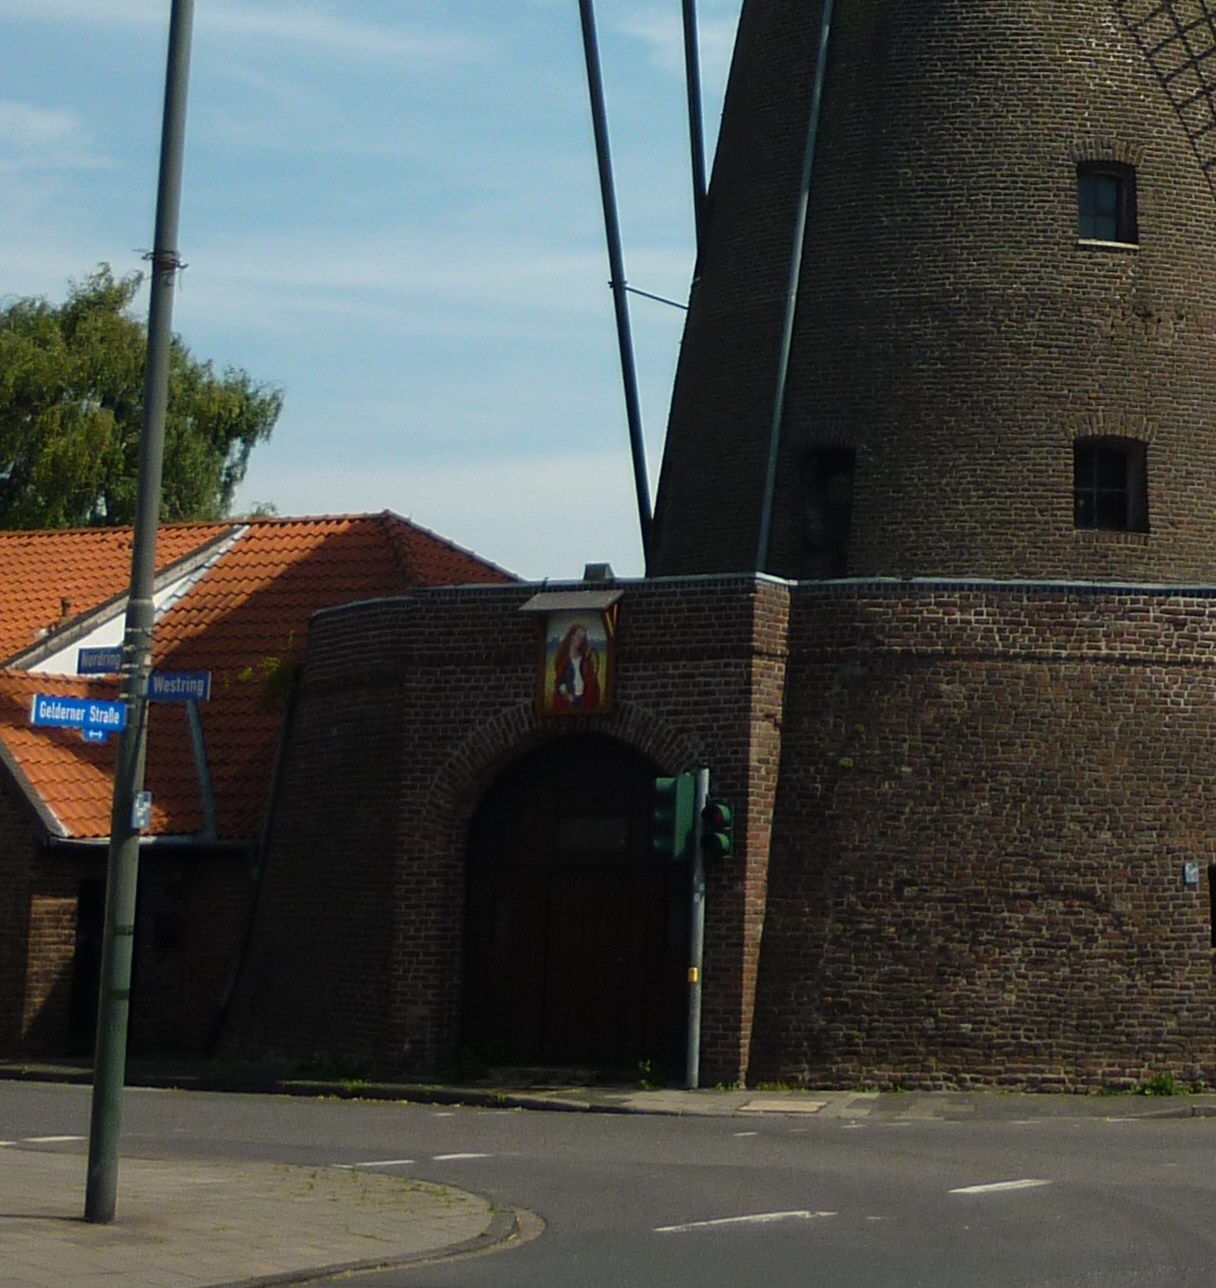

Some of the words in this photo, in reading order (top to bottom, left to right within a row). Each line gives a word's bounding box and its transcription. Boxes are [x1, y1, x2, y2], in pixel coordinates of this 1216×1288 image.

[153, 676, 204, 697] Westring
[40, 700, 86, 721] Gelderner
[89, 705, 120, 724] Straße
